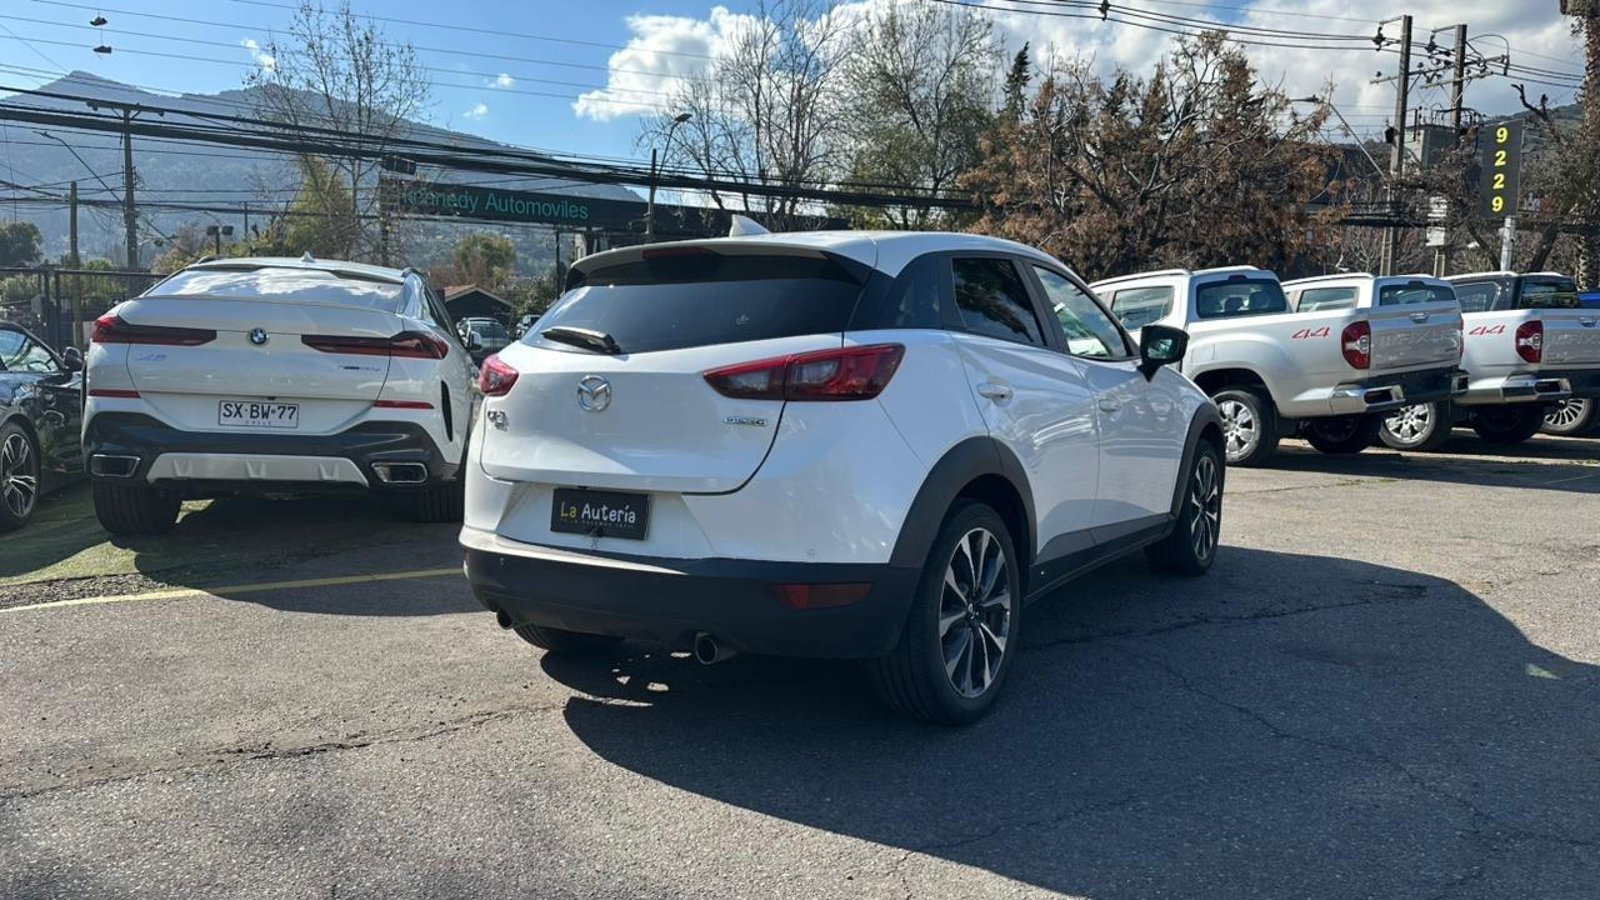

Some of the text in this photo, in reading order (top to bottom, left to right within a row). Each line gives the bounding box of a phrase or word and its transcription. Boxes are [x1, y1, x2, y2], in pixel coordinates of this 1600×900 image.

[485, 192, 589, 219] Automoviles
[560, 501, 636, 523] La Autería
